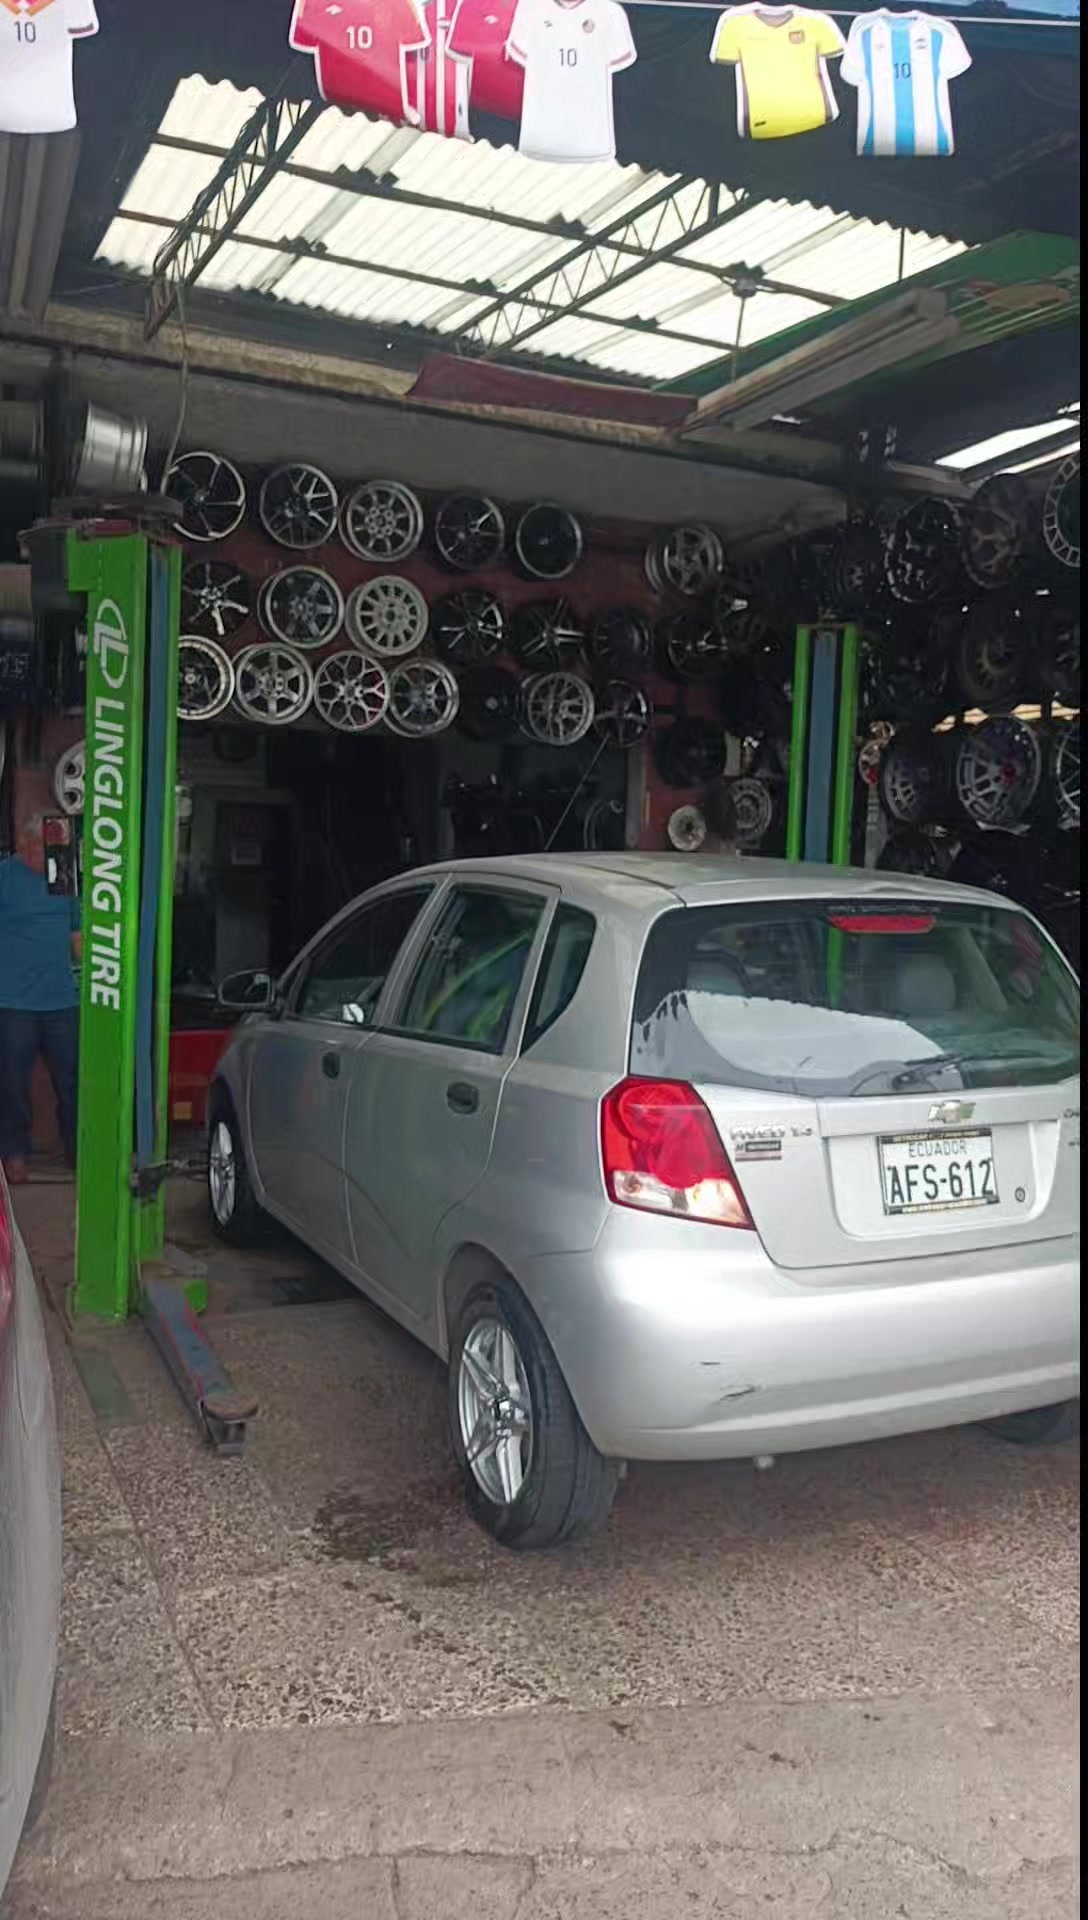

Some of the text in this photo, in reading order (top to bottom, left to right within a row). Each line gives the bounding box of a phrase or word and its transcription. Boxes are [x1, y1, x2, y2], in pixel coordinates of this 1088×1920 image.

[14, 20, 36, 43] 10
[346, 25, 373, 49] 10
[559, 48, 577, 67] 10
[893, 62, 912, 79] 10
[90, 696, 124, 1011] LINGLONG TIRE
[909, 1140, 967, 1158] ECUADOR
[887, 1158, 994, 1204] AFS-612
